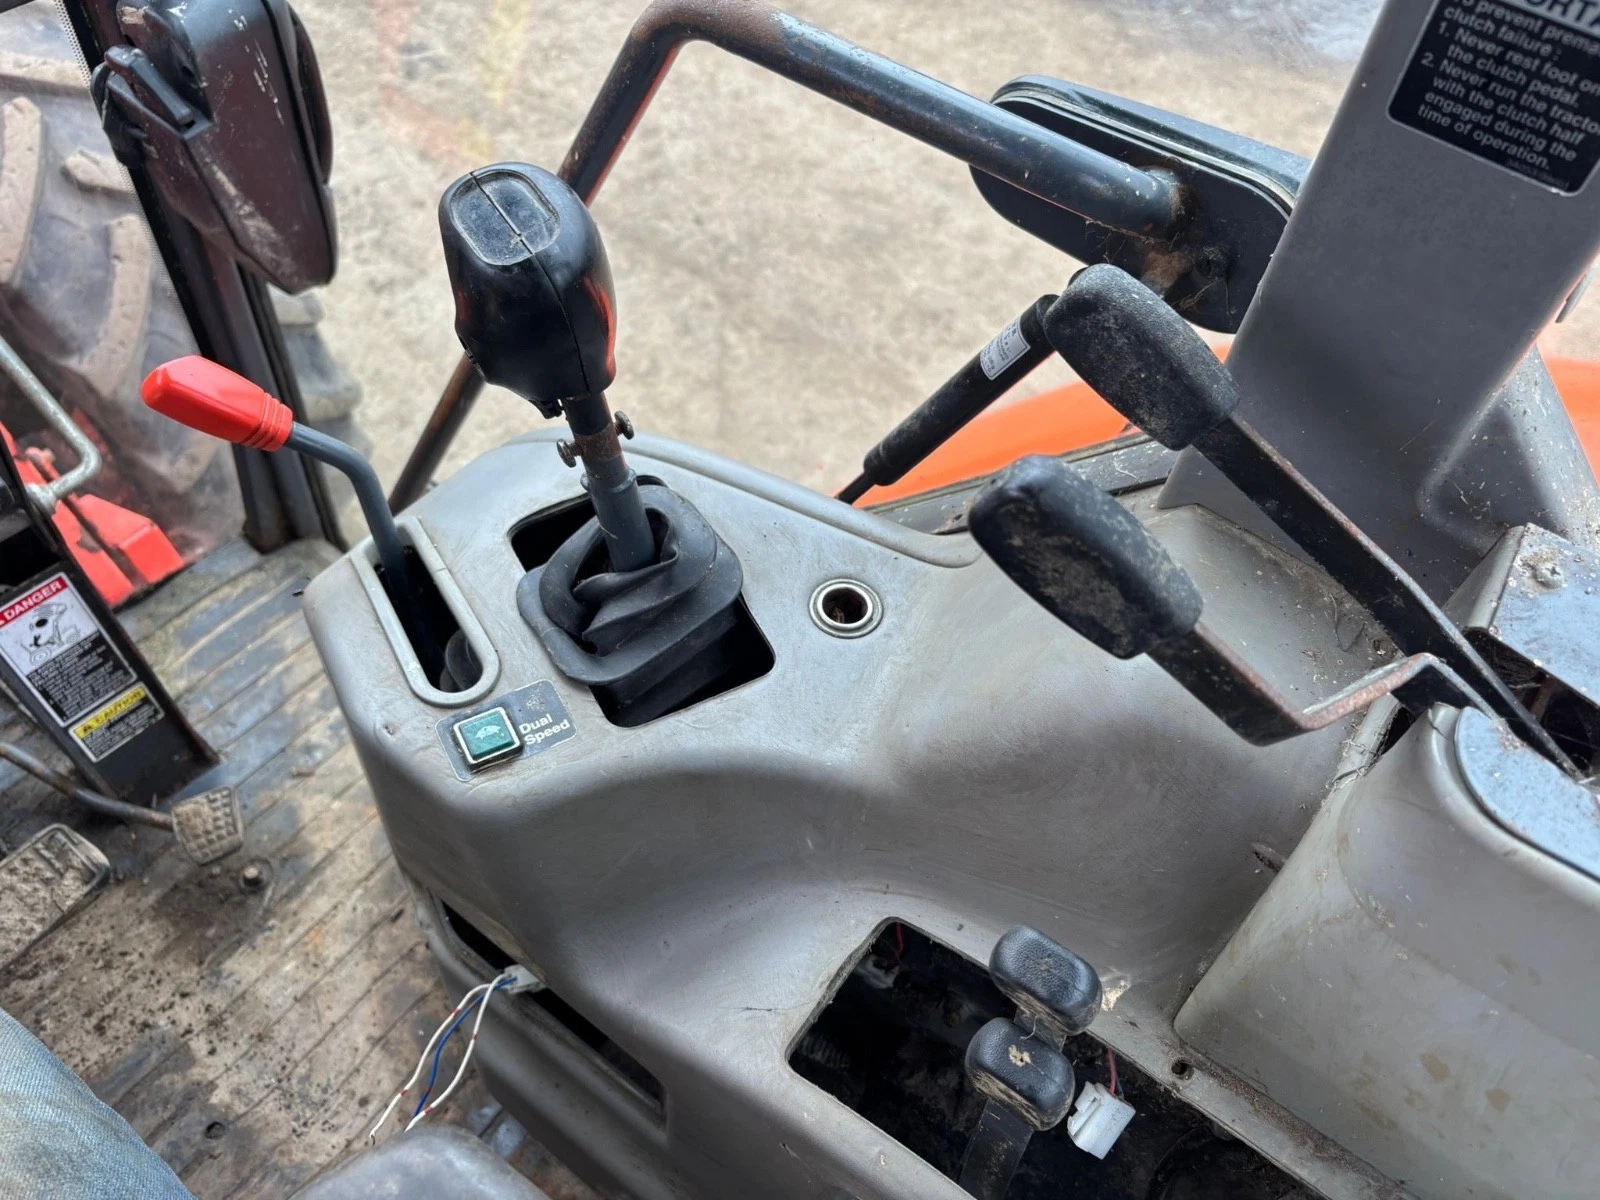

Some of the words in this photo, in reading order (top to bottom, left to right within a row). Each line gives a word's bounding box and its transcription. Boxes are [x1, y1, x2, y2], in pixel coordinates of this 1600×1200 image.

[1444, 7, 1495, 35] clutch
[1497, 25, 1552, 57] failure
[1475, 1, 1543, 32] prevent
[1439, 21, 1449, 37] 1.
[1454, 27, 1503, 56] Never
[1505, 51, 1540, 72] rest
[1541, 62, 1578, 86] foot
[1579, 79, 1600, 96] on
[1447, 44, 1474, 64] the
[1476, 57, 1527, 85] clutch
[1528, 79, 1579, 108] pedal.
[1421, 52, 1434, 67] 2.
[1439, 59, 1488, 87] Never
[1488, 82, 1517, 101] run
[1519, 92, 1547, 113] the
[1549, 105, 1600, 136] tracto
[1433, 76, 1466, 98] with
[1469, 90, 1494, 110] the
[1496, 103, 1547, 131] clutch
[1549, 123, 1586, 145] half
[1418, 104, 1451, 127] time
[1454, 121, 1473, 135] of
[1473, 130, 1550, 170] operation.
[1425, 92, 1493, 127] engaged
[1494, 120, 1547, 152] during
[1548, 142, 1577, 161] the
[3, 580, 63, 621] DANGER
[518, 713, 553, 735] Dual
[523, 718, 571, 746] Speed
